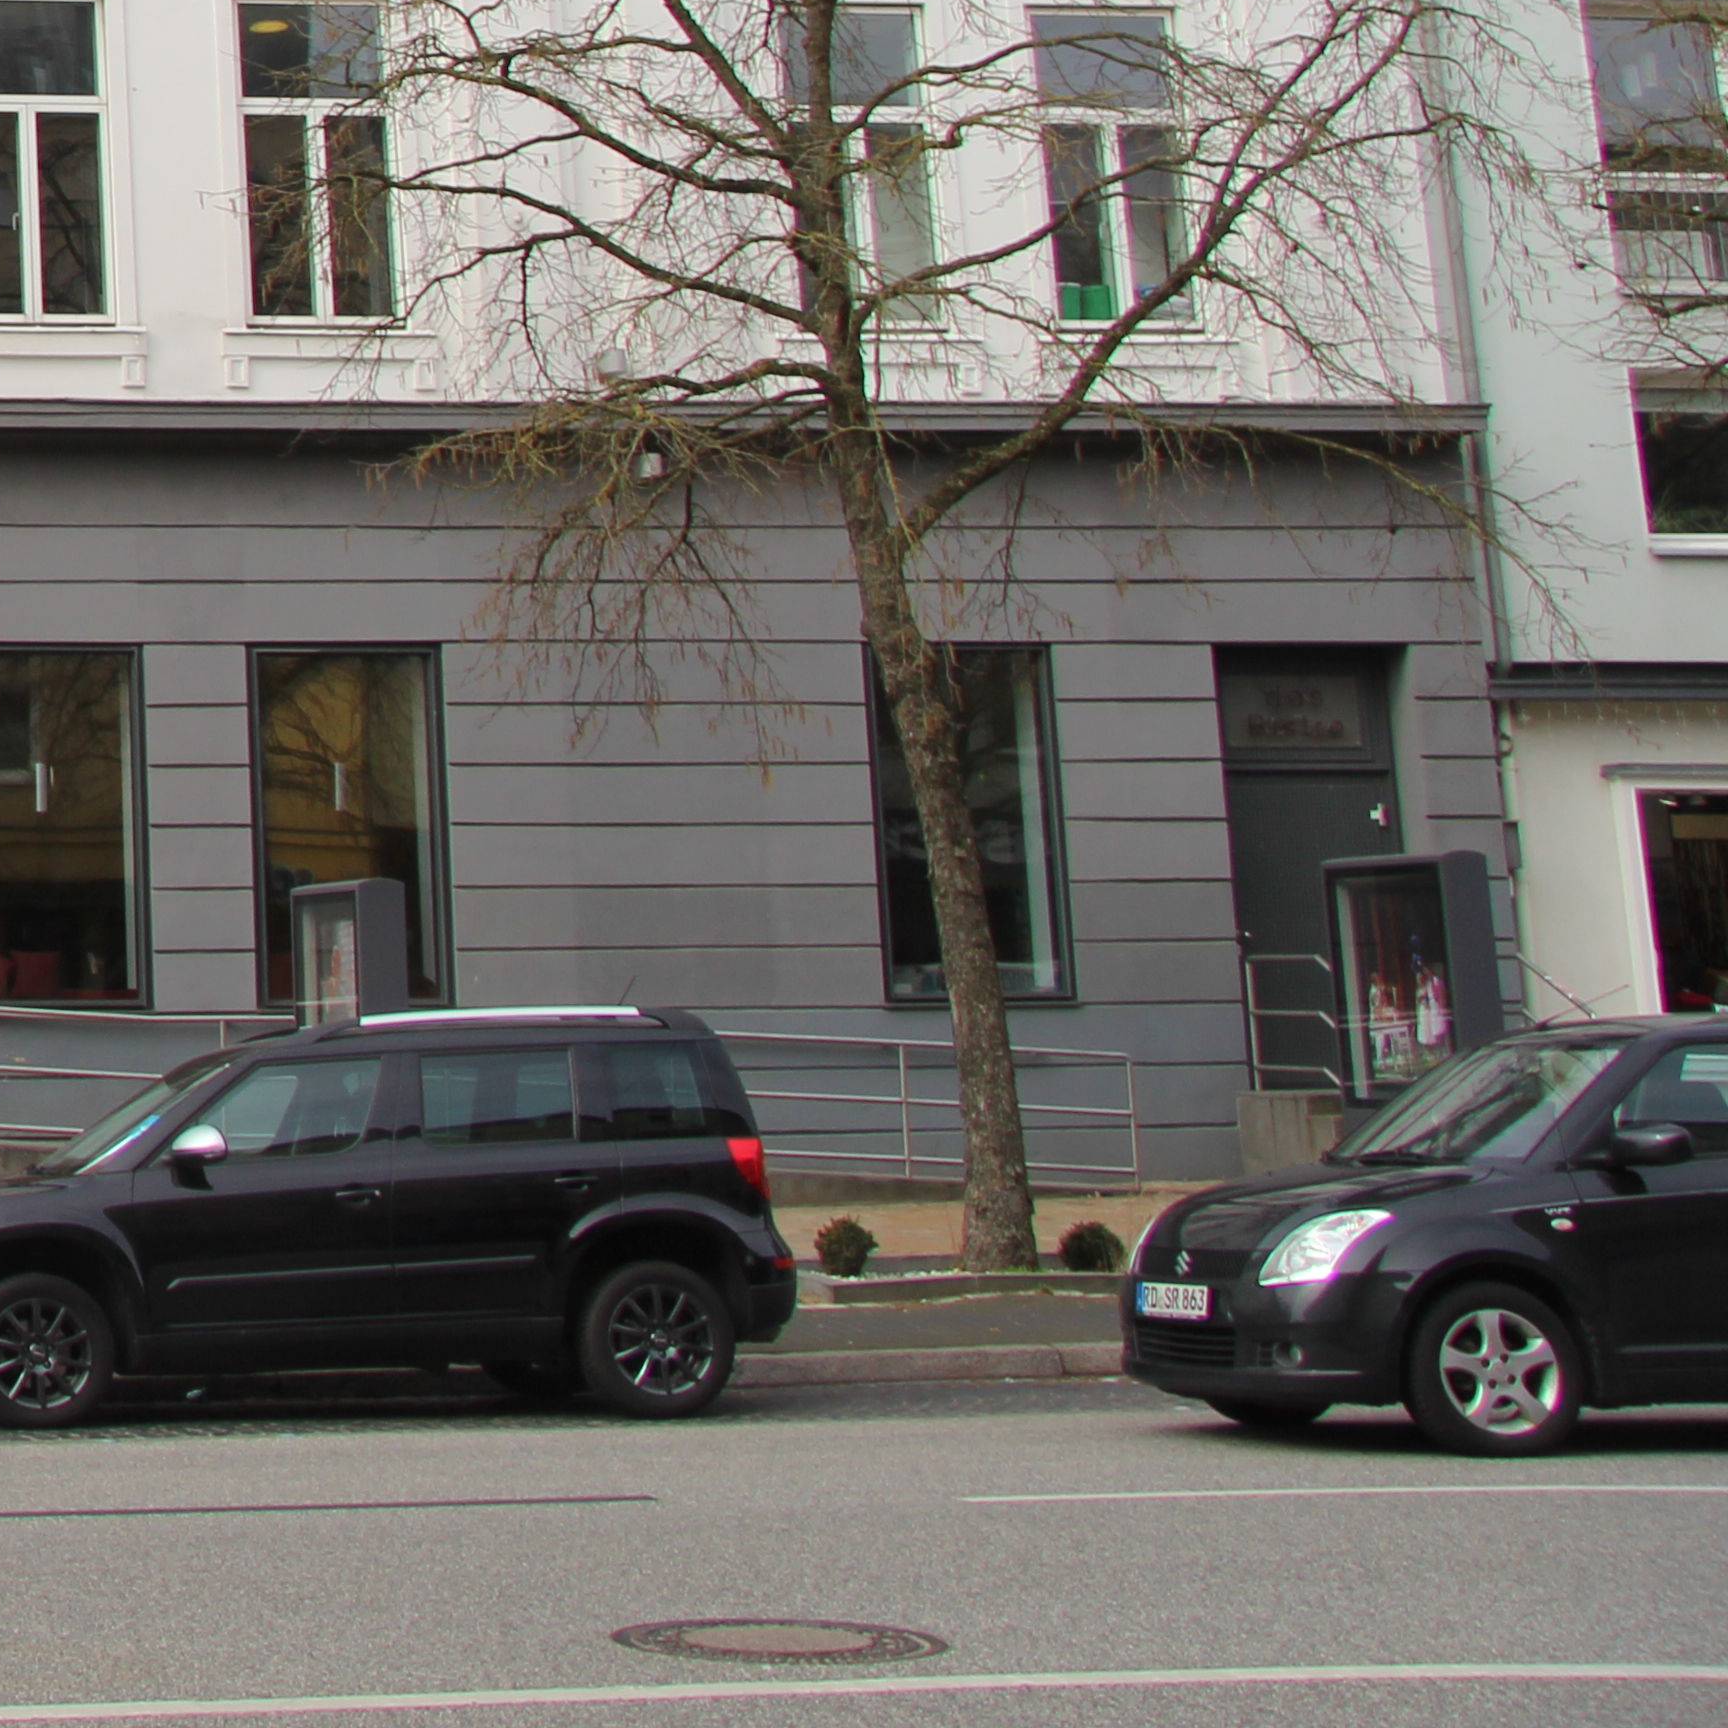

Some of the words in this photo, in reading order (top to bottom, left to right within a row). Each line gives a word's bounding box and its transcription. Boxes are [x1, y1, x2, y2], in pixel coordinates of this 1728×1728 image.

[1144, 1286, 1158, 1308] RD
[1164, 1287, 1180, 1309] SR
[1183, 1288, 1205, 1311] 863
